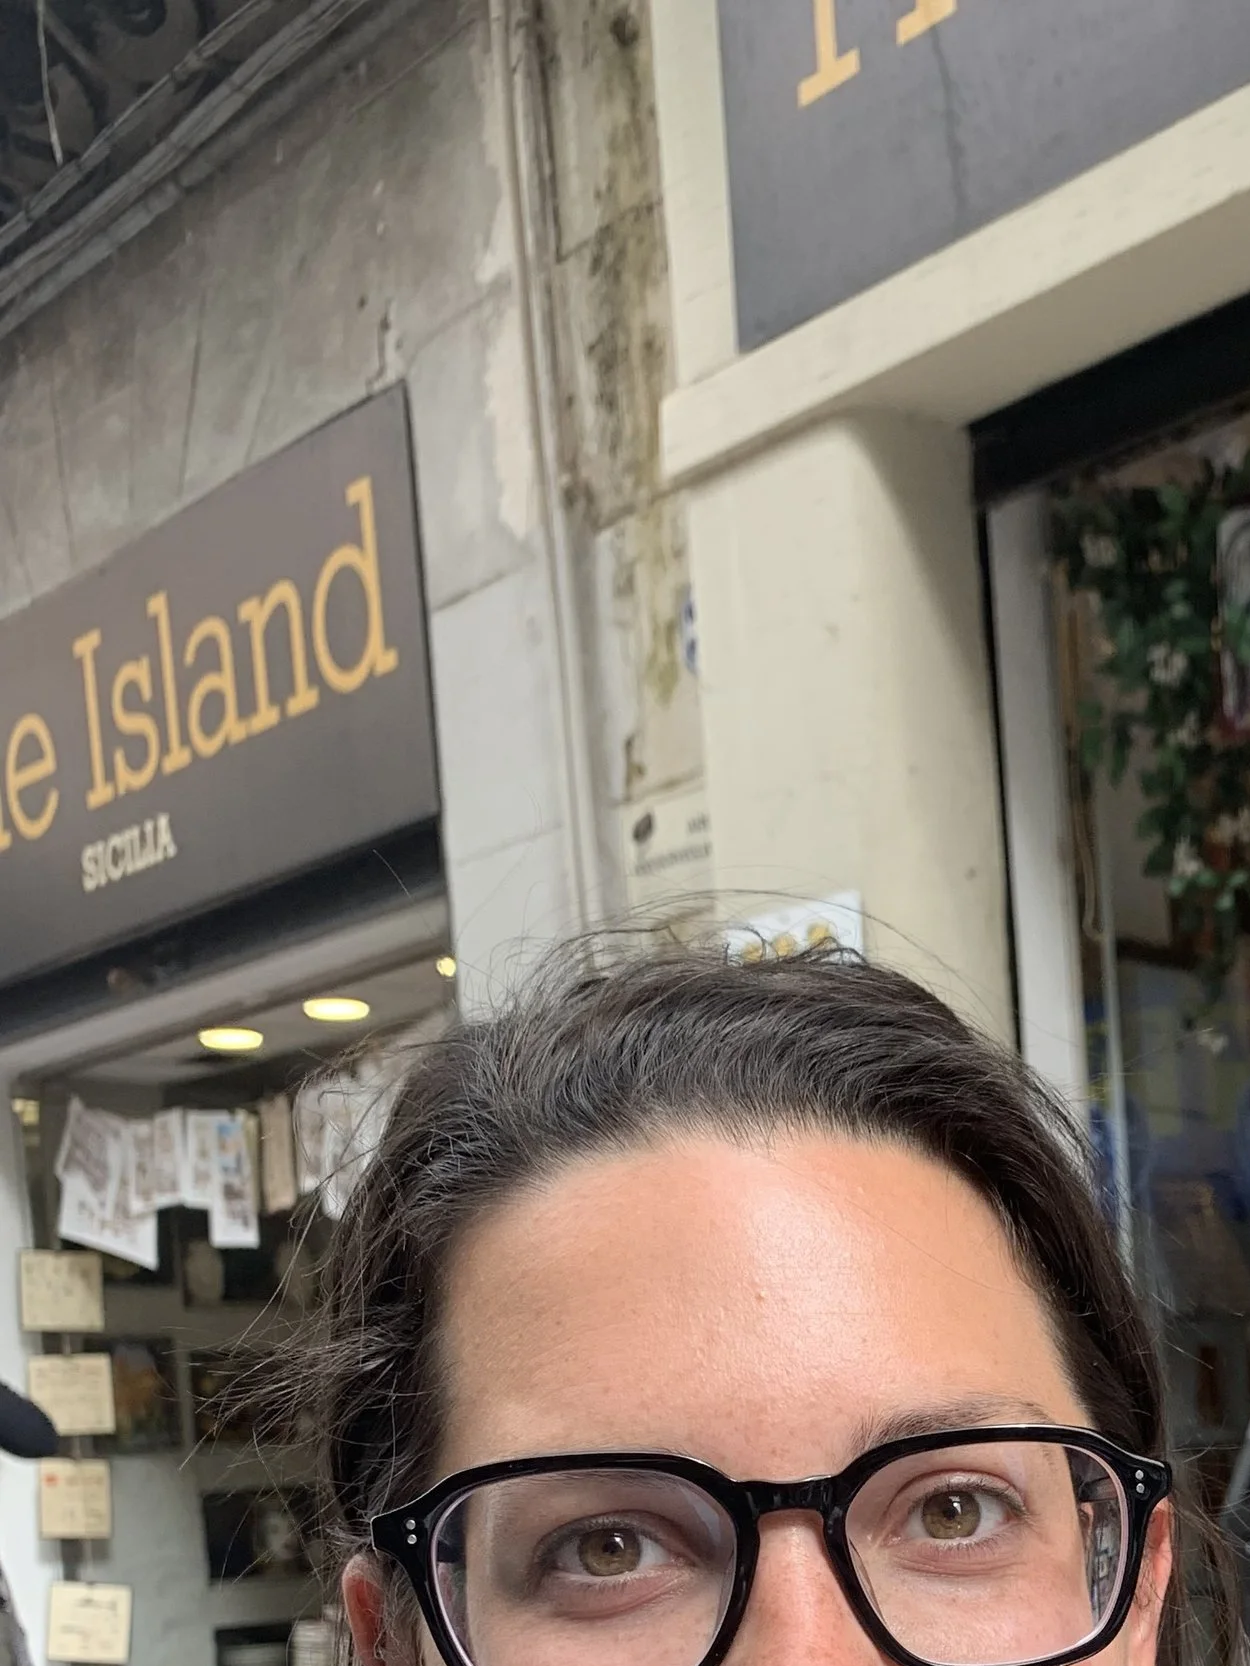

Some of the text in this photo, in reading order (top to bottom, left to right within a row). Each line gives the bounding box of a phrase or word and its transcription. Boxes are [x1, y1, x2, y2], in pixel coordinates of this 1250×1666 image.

[0, 476, 398, 852] e Island
[81, 813, 178, 891] SICILIA
